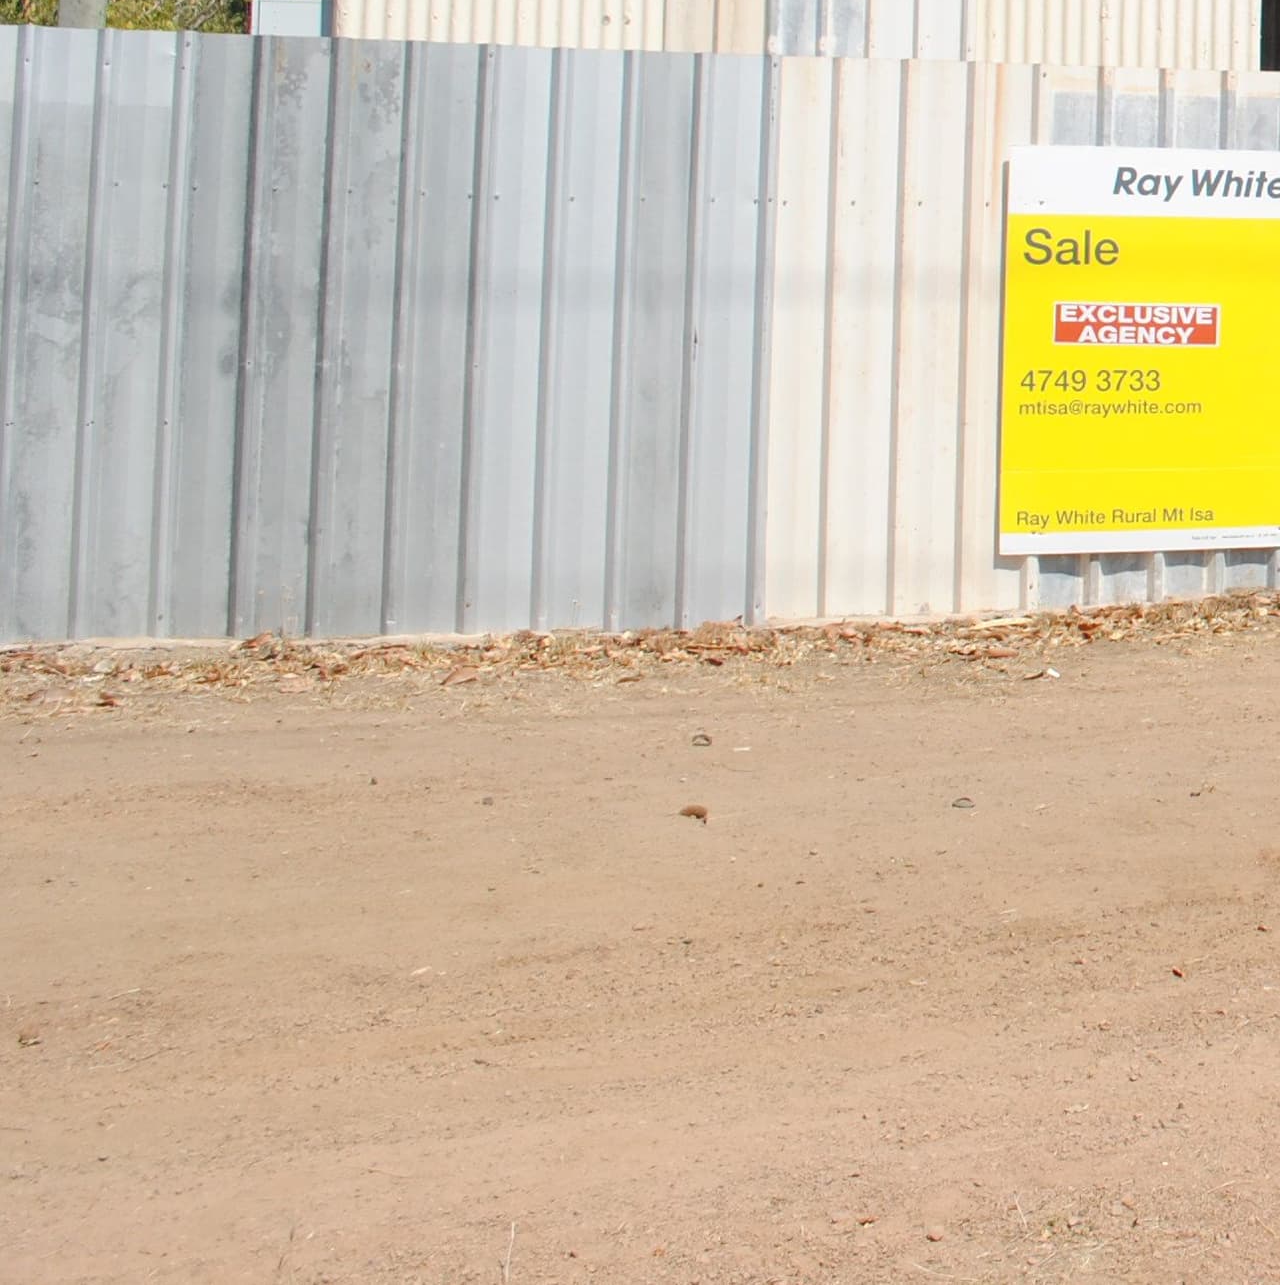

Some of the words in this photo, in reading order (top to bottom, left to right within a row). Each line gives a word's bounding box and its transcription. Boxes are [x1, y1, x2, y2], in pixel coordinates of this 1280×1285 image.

[1112, 166, 1183, 202] Ray
[1023, 228, 1120, 265] Sale
[1059, 304, 1213, 325] EXCLUSIVE
[1077, 325, 1195, 344] AGENCY
[1019, 370, 1087, 392] 4749
[1095, 370, 1161, 392] 3733
[1018, 399, 1202, 418] mtisa@raywhite.com
[1016, 511, 1049, 528] Ray
[1056, 509, 1106, 525] White
[1112, 509, 1156, 524] Rural
[1162, 508, 1184, 522] Mt
[1190, 508, 1214, 521] Isa
